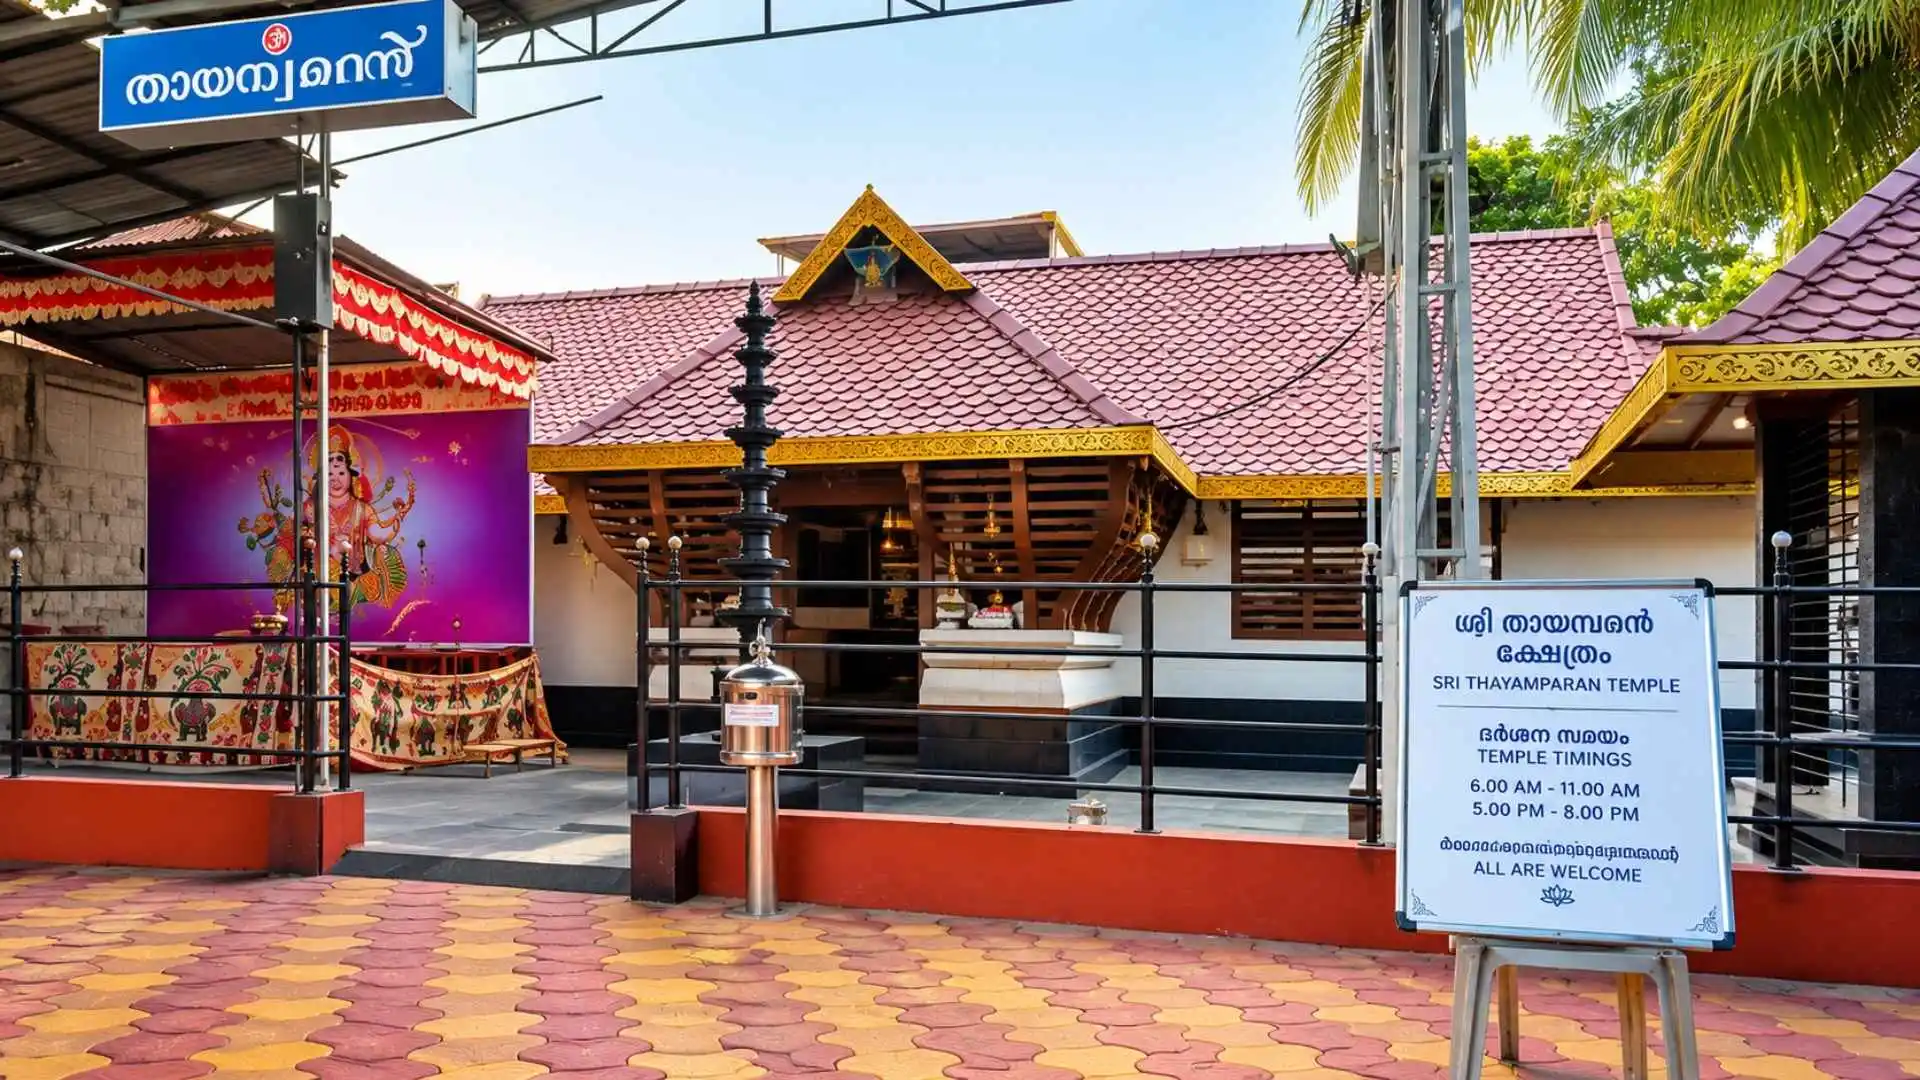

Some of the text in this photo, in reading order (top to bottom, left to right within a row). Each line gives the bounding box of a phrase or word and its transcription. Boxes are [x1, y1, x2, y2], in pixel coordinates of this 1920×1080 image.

[1433, 675, 1681, 694] SRI THAYAMPARAN TEMPLE
[1477, 748, 1632, 768] TEMPLE TIMINGS
[1470, 778, 1509, 794] 6.00
[1514, 780, 1542, 795] AM
[1560, 781, 1605, 797] 11.00
[1610, 783, 1641, 798] AM
[1472, 801, 1511, 817] 5.00
[1517, 803, 1545, 818] PM
[1563, 805, 1604, 821] 8.00
[1610, 806, 1640, 822] PM
[1473, 861, 1642, 883] ALL ARE WELCOME
